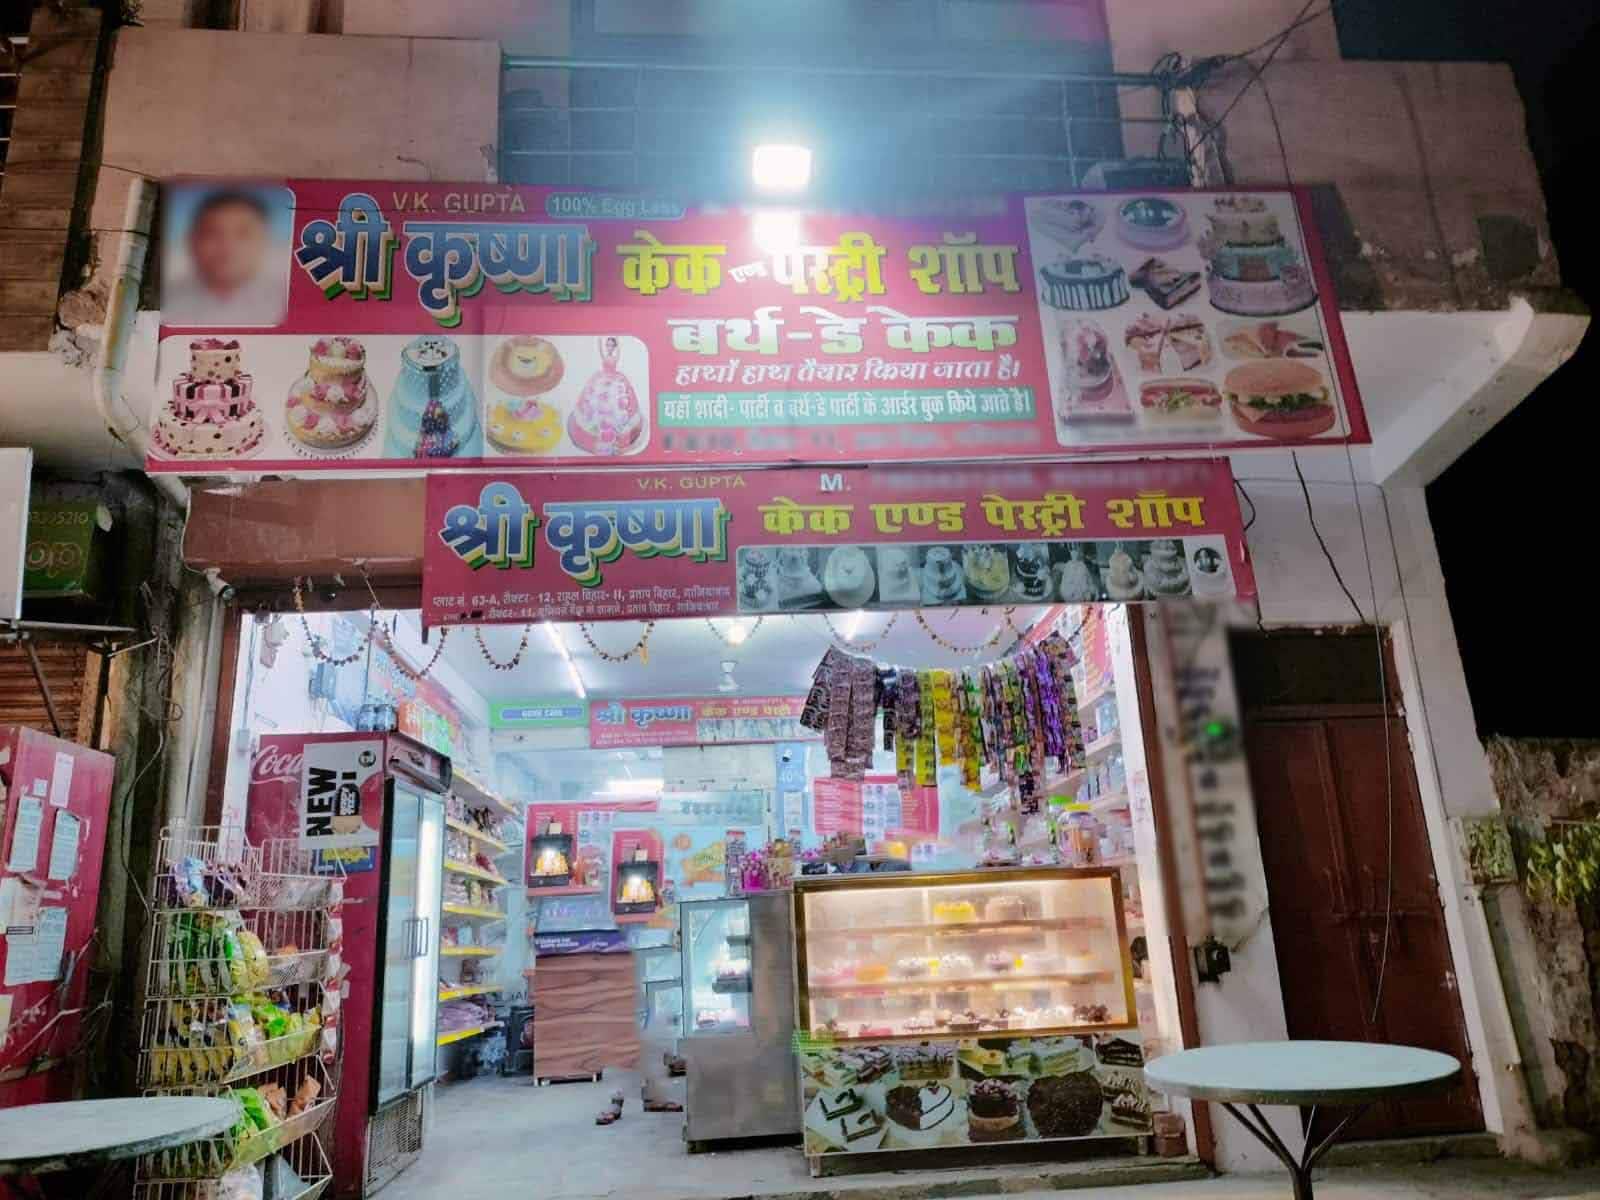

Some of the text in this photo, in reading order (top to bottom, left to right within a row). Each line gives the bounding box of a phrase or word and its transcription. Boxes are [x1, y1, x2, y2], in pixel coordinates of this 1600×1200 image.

[392, 191, 526, 213] V.K. GUPTA
[551, 196, 596, 213] 100%
[295, 193, 399, 300] श्री
[403, 222, 596, 327] कृष्णा
[616, 229, 727, 296] केक
[908, 231, 1020, 297] शॉप
[867, 306, 1019, 353] केक
[742, 363, 792, 385] हाथ
[796, 360, 859, 384] तैयार
[864, 359, 926, 384] किया
[932, 360, 991, 381] जाता
[738, 392, 769, 418] पार्टी
[862, 392, 876, 417] के
[638, 477, 673, 491] V.K.
[680, 474, 746, 490] GUPTA
[439, 482, 1206, 586] श्री कृष्णा केक एण्ड पेस्ट्री शॉप
[306, 767, 337, 837] NEW
